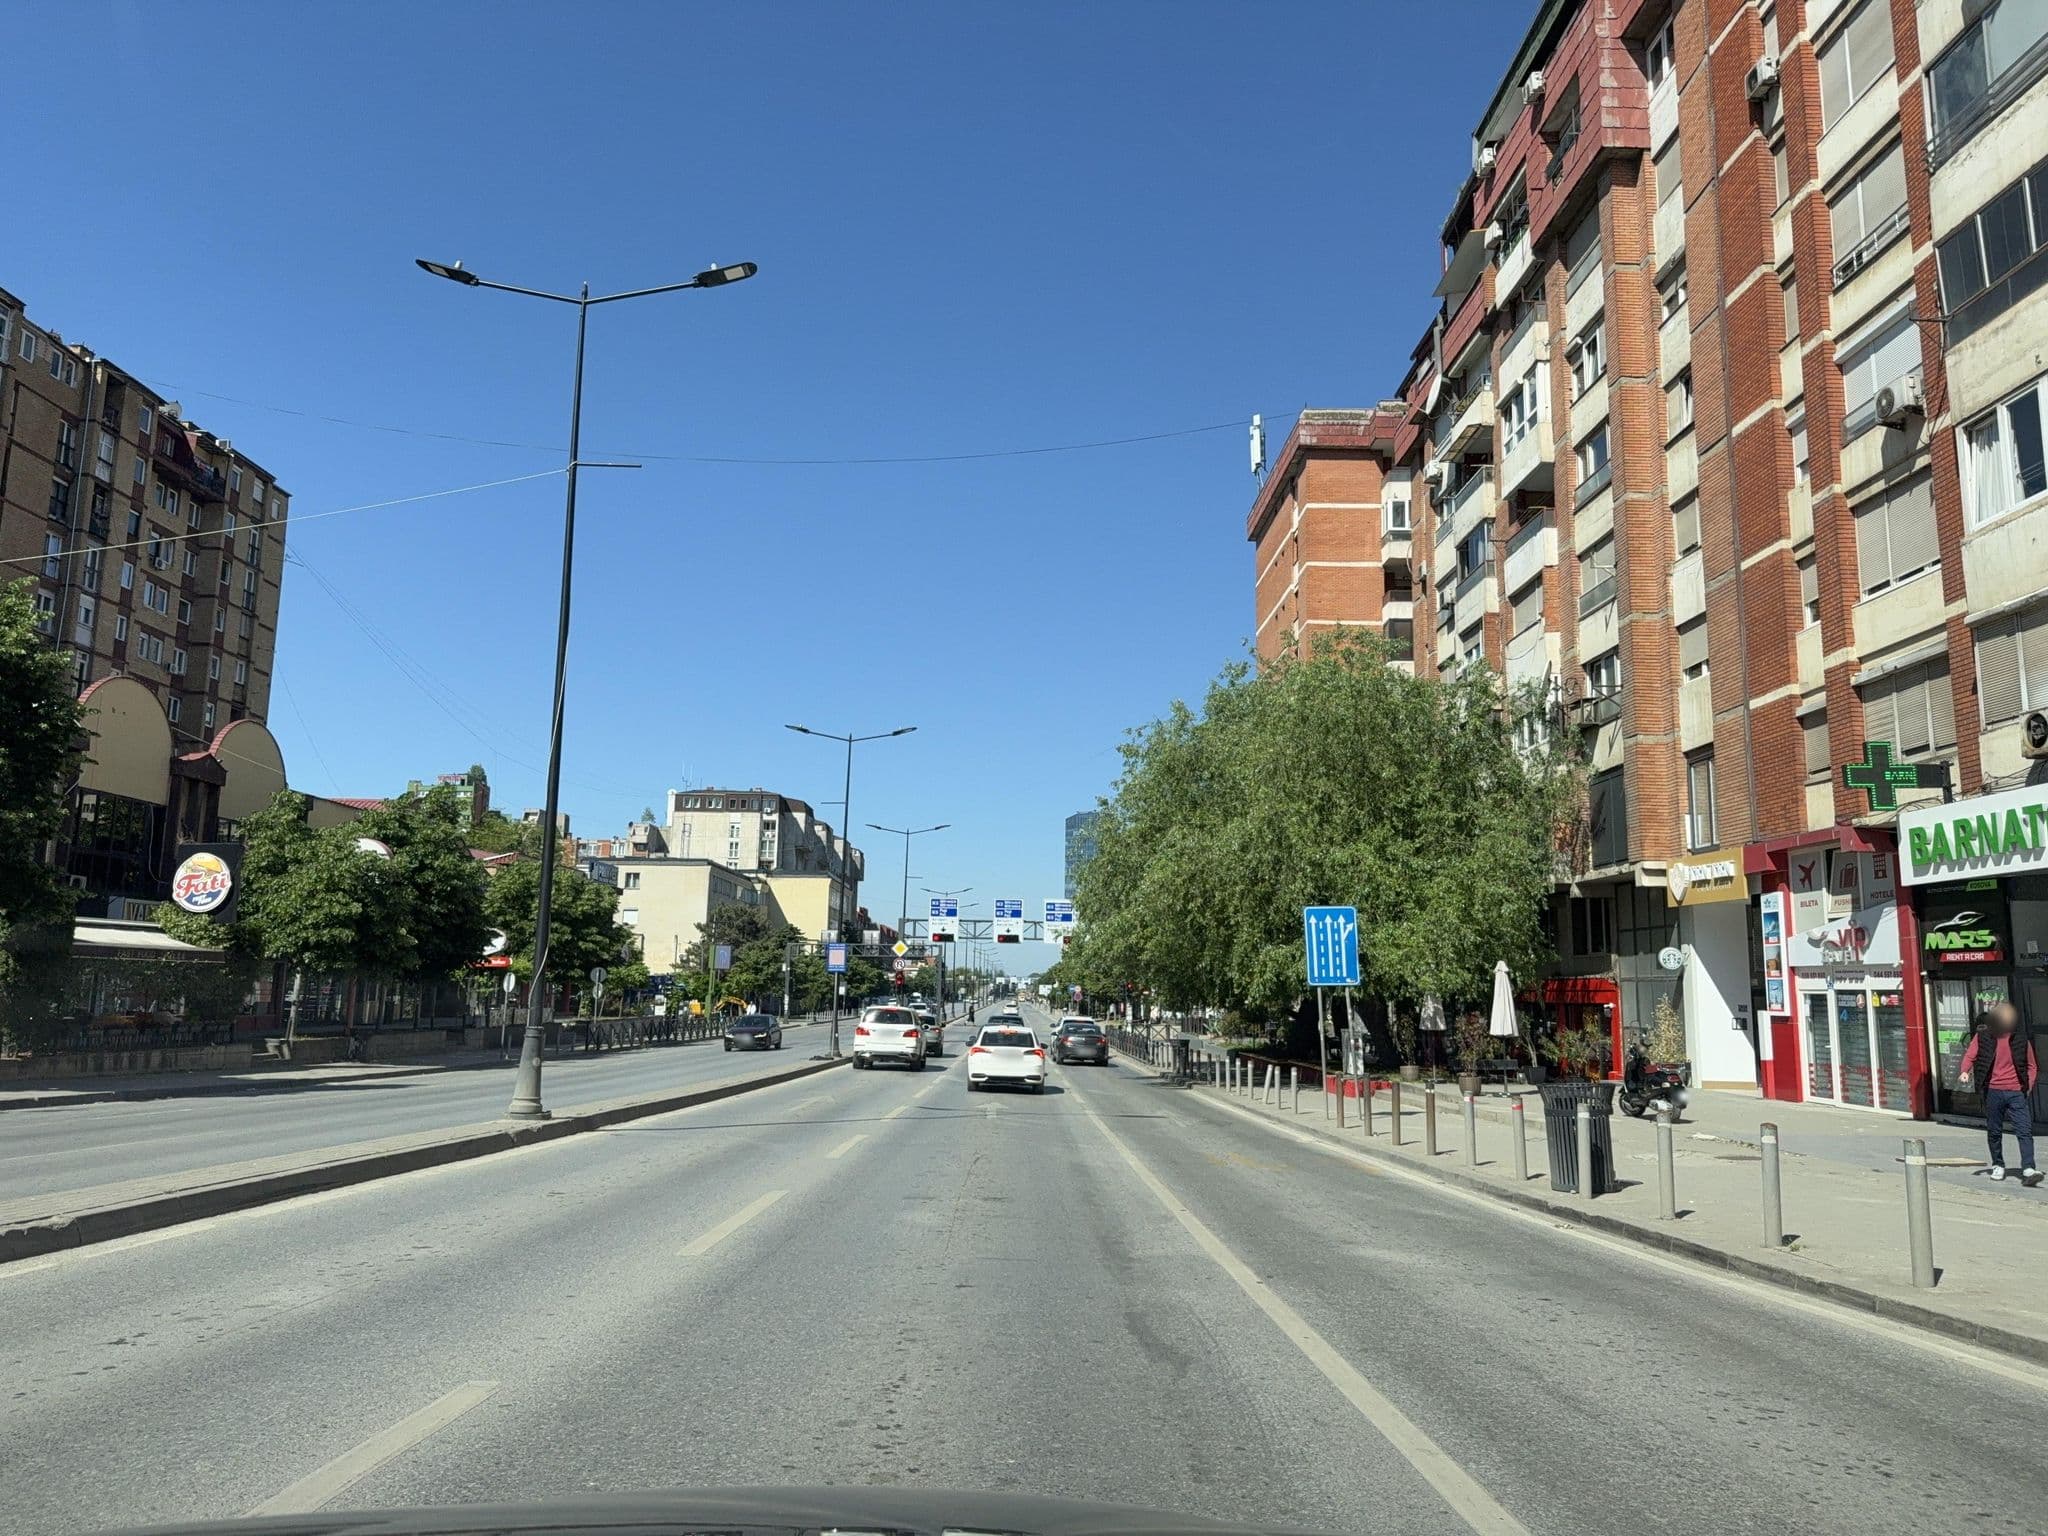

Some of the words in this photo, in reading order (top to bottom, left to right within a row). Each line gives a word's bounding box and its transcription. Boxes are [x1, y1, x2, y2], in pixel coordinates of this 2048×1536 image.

[1908, 803, 2048, 866] BARNAT
[175, 872, 229, 899] Fati
[1800, 899, 1819, 908] BILETA
[1925, 929, 1997, 950] MARS
[1946, 952, 1963, 961] RENT
[1970, 951, 1985, 961] CAR
